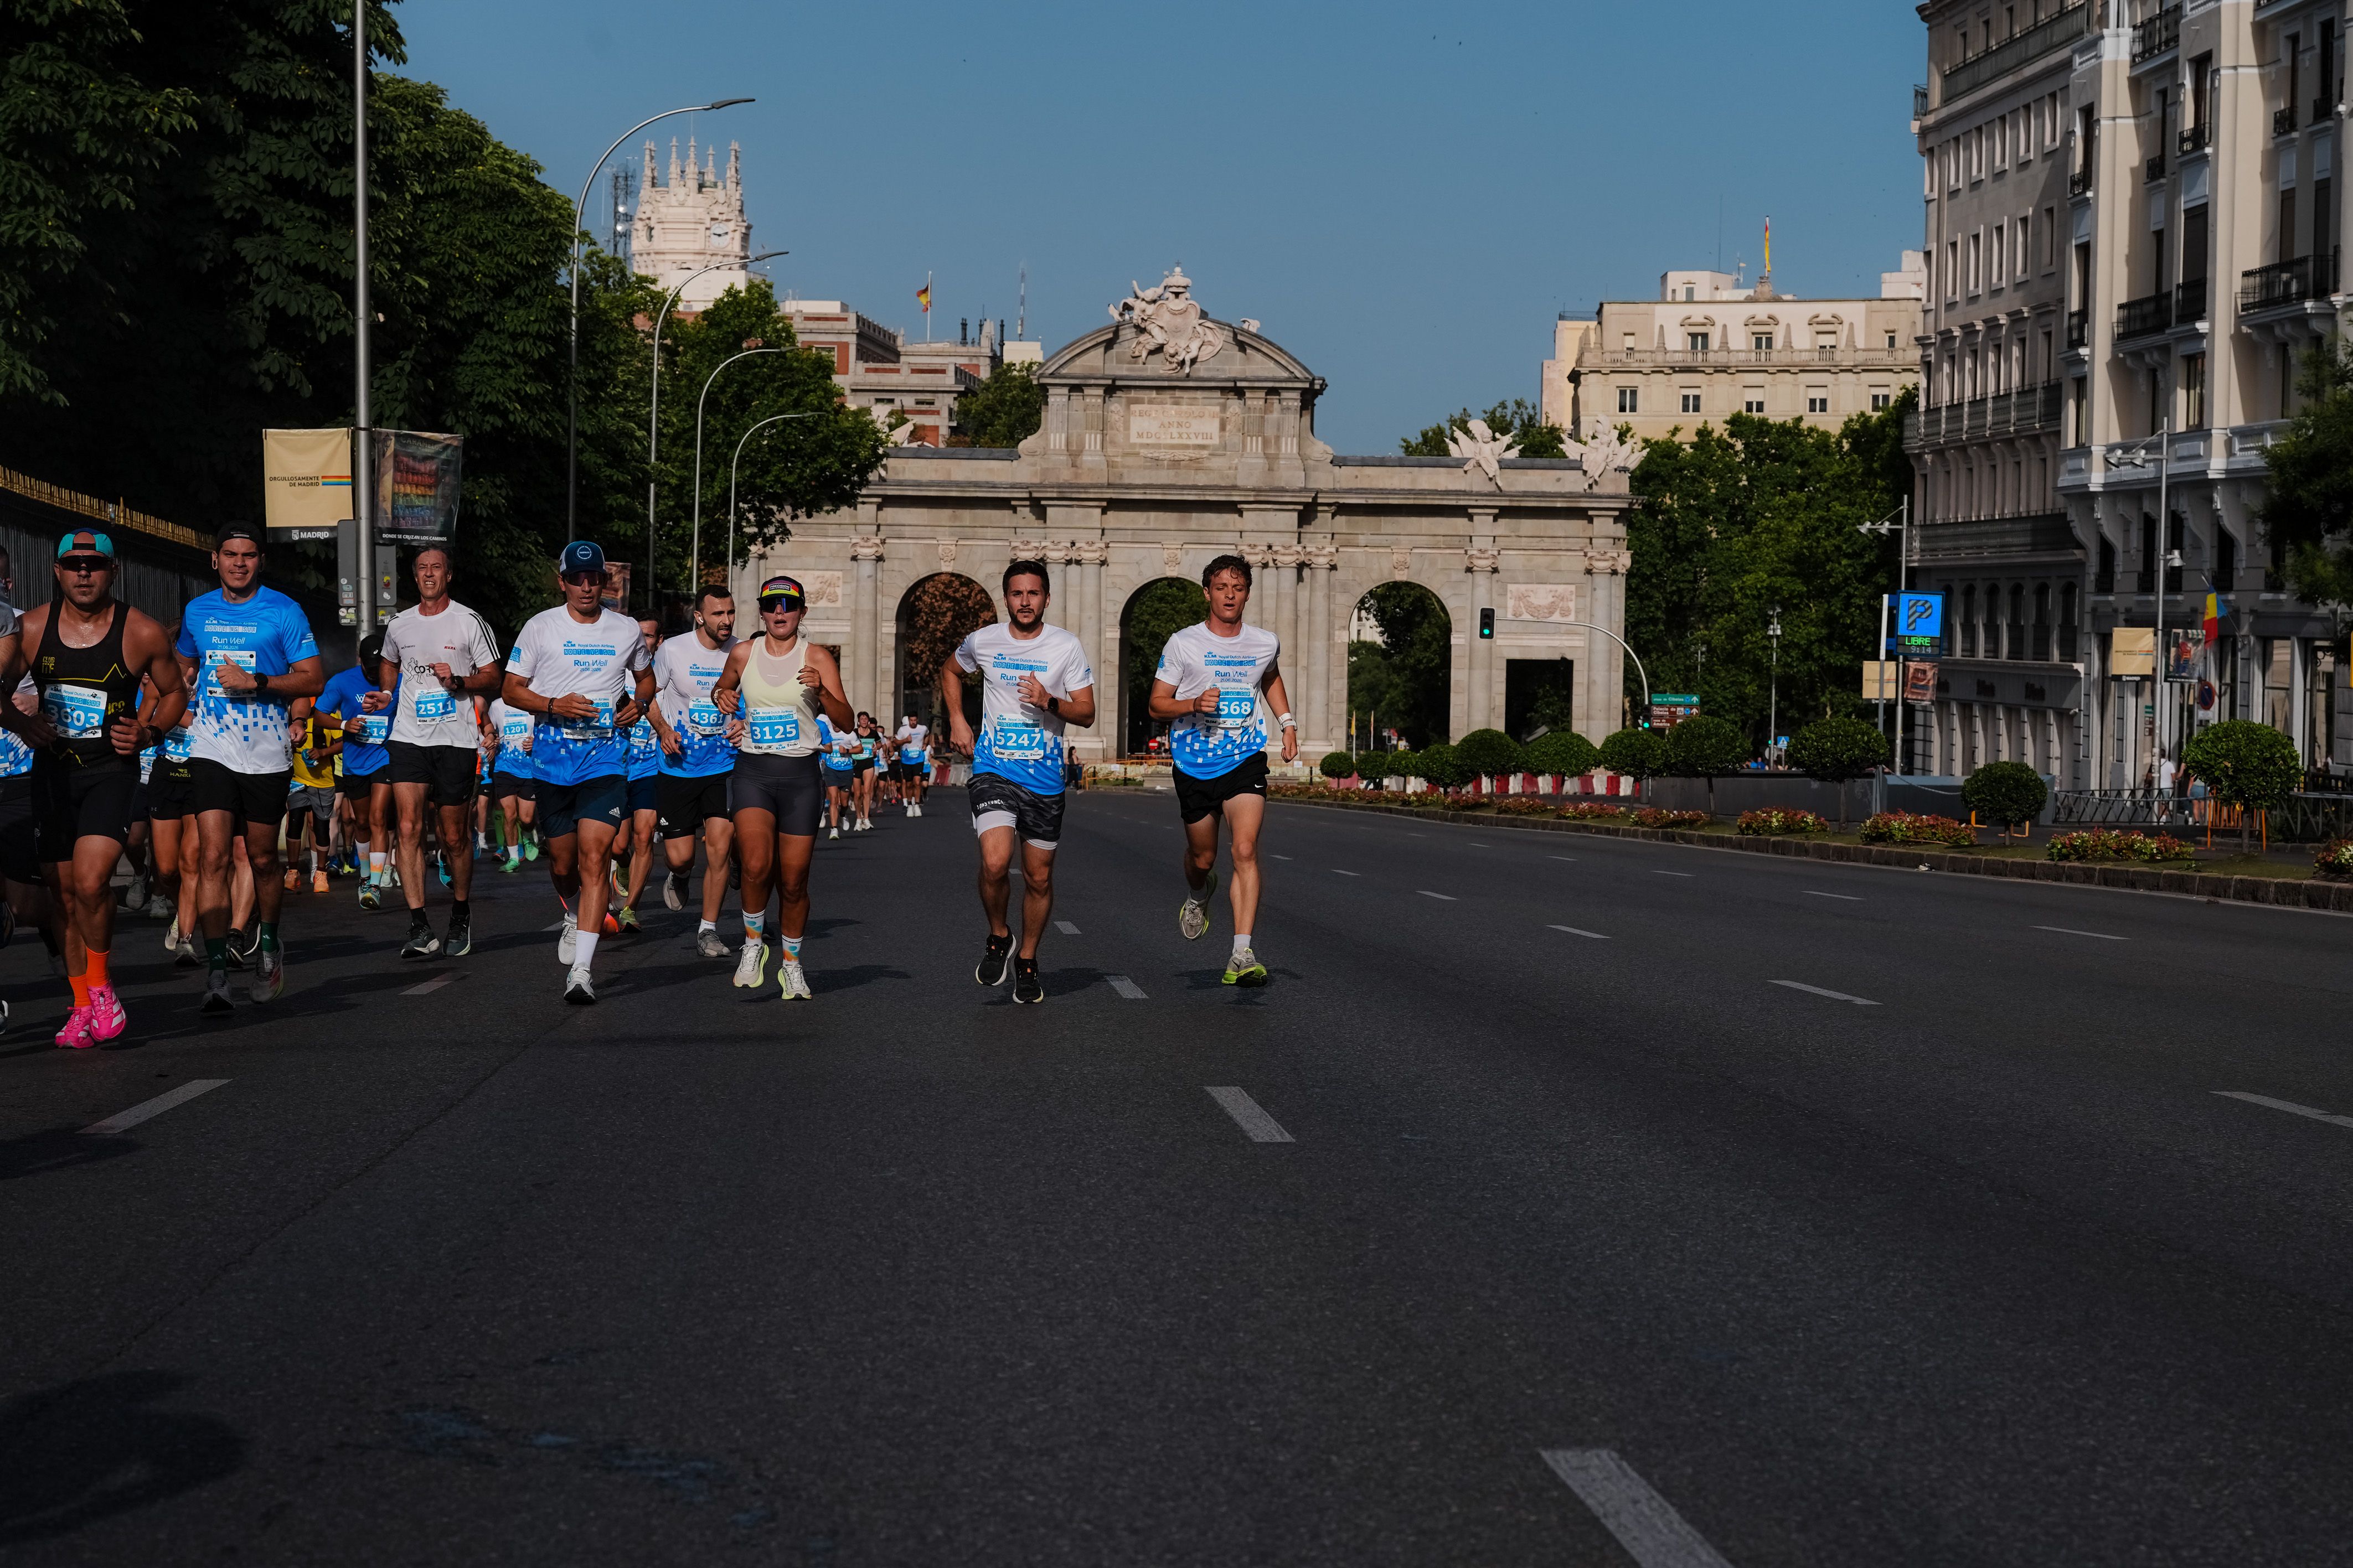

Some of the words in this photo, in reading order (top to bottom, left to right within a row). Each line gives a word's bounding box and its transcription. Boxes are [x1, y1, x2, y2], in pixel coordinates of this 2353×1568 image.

[1905, 636, 1931, 646] LIBRE
[993, 661, 1015, 670] NORTE
[1020, 662, 1029, 671] VS
[1033, 663, 1048, 672] SUR
[49, 692, 70, 702] NORTE
[87, 699, 101, 707] SUR
[419, 700, 453, 715] 2511
[1214, 702, 1251, 715] 568
[48, 705, 100, 728] 3603
[691, 712, 724, 723] 4361
[752, 724, 796, 739] 3125
[997, 732, 1041, 747] 5247
